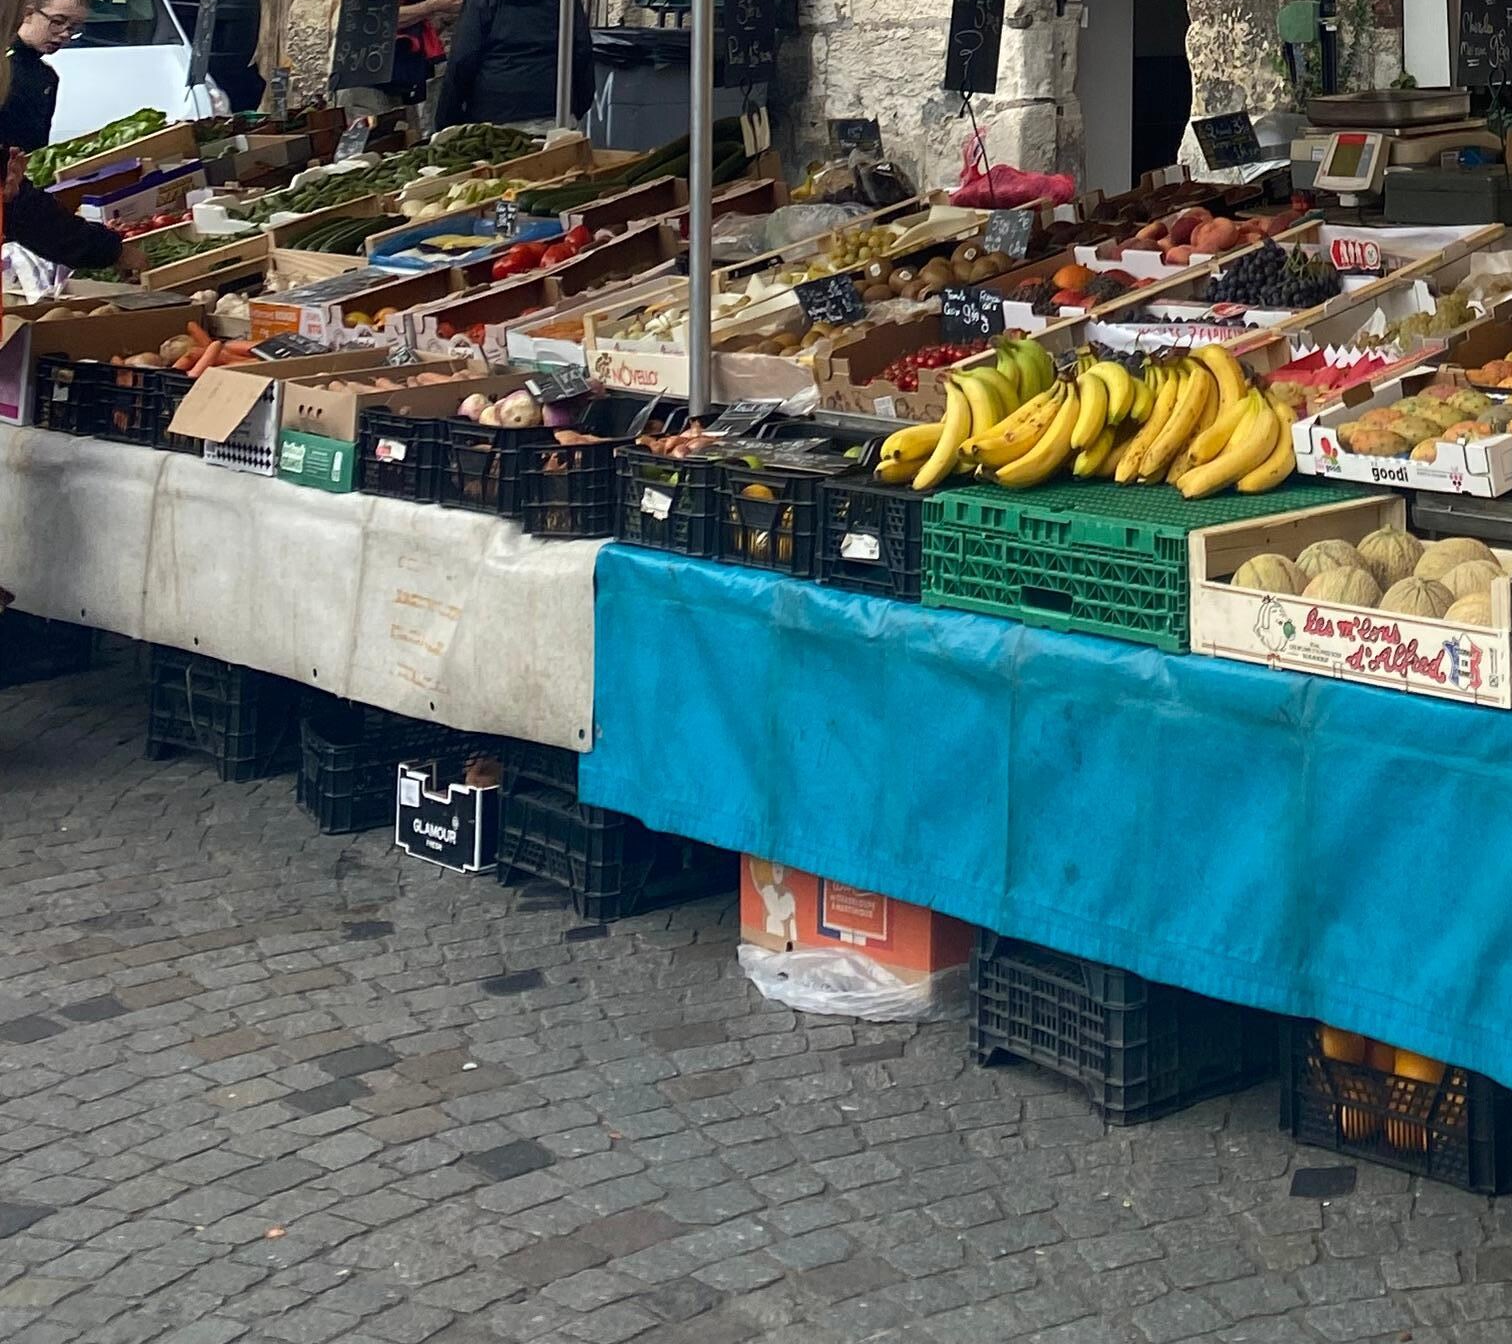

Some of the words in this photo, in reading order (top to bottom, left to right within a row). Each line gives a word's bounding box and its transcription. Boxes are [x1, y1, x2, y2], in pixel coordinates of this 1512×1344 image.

[1371, 466, 1409, 483] goodi
[1345, 638, 1448, 684] d'Alfred
[412, 817, 457, 846] GLAMOUR
